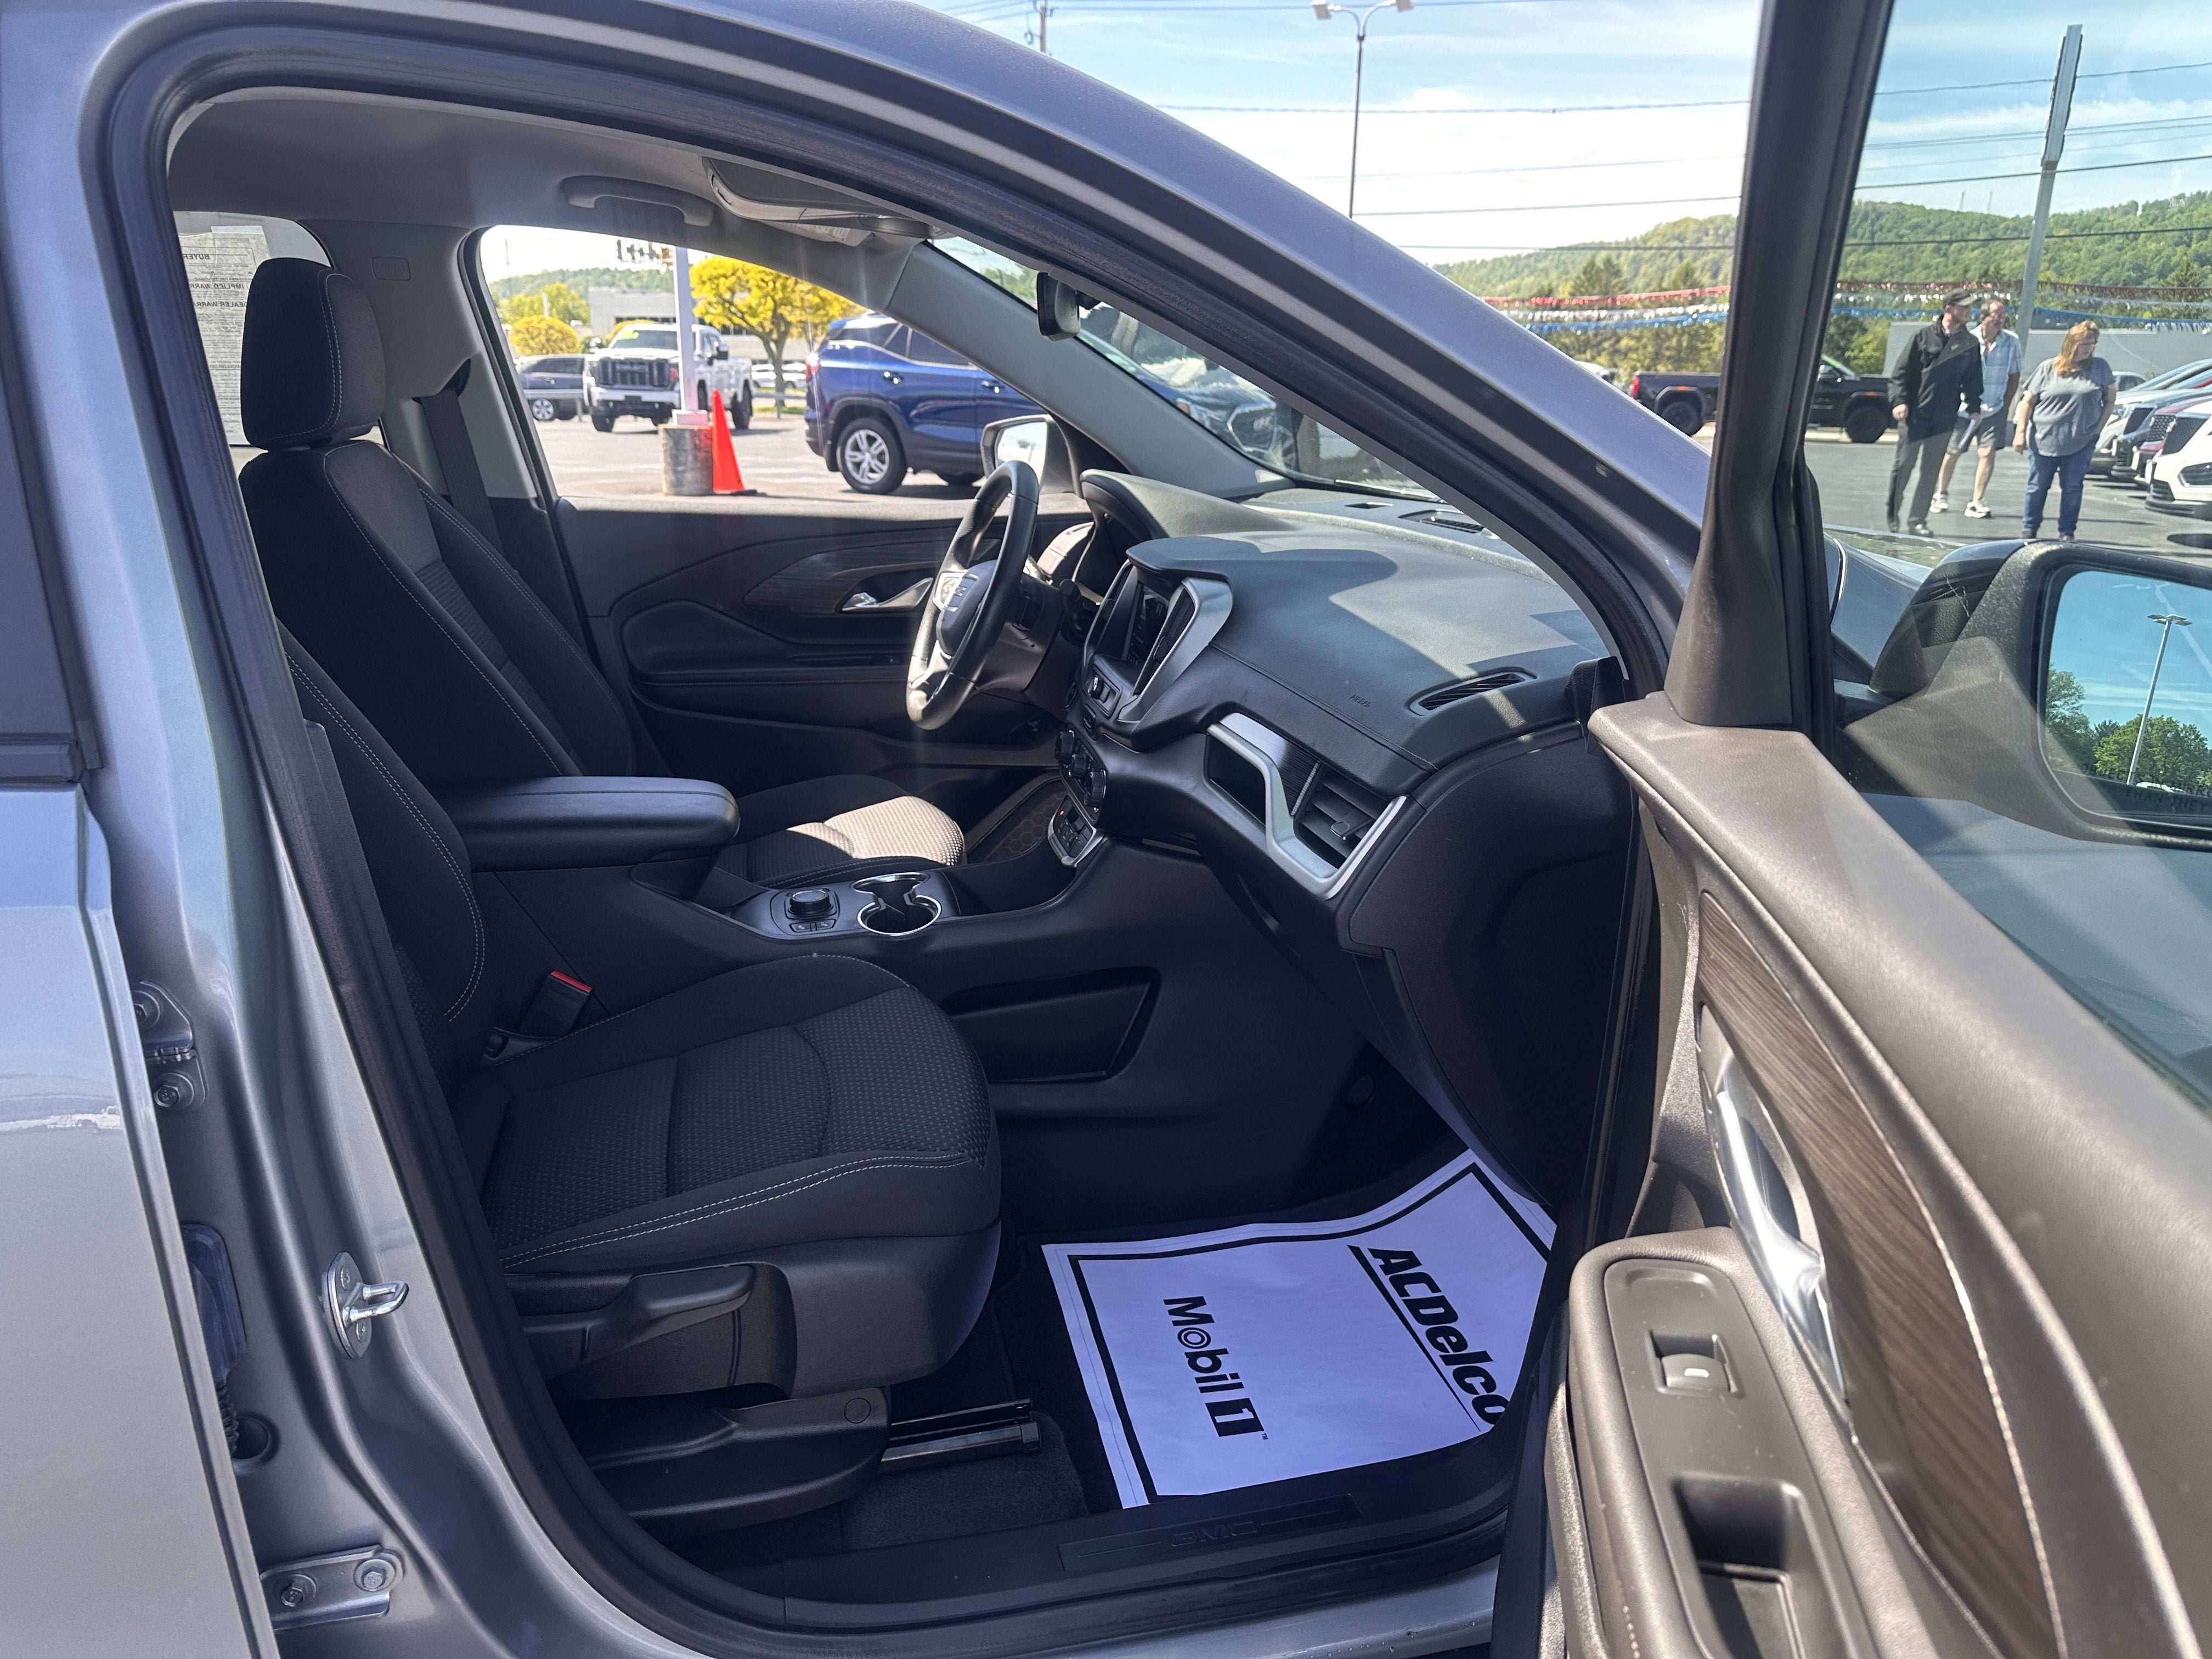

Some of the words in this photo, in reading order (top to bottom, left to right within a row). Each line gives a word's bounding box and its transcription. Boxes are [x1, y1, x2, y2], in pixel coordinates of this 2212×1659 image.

[1349, 693, 1372, 708] AIRBAG
[1163, 1296, 1244, 1393] Mobil
[1368, 1248, 1509, 1425] ACDelco
[1171, 1520, 1259, 1547] GMC
